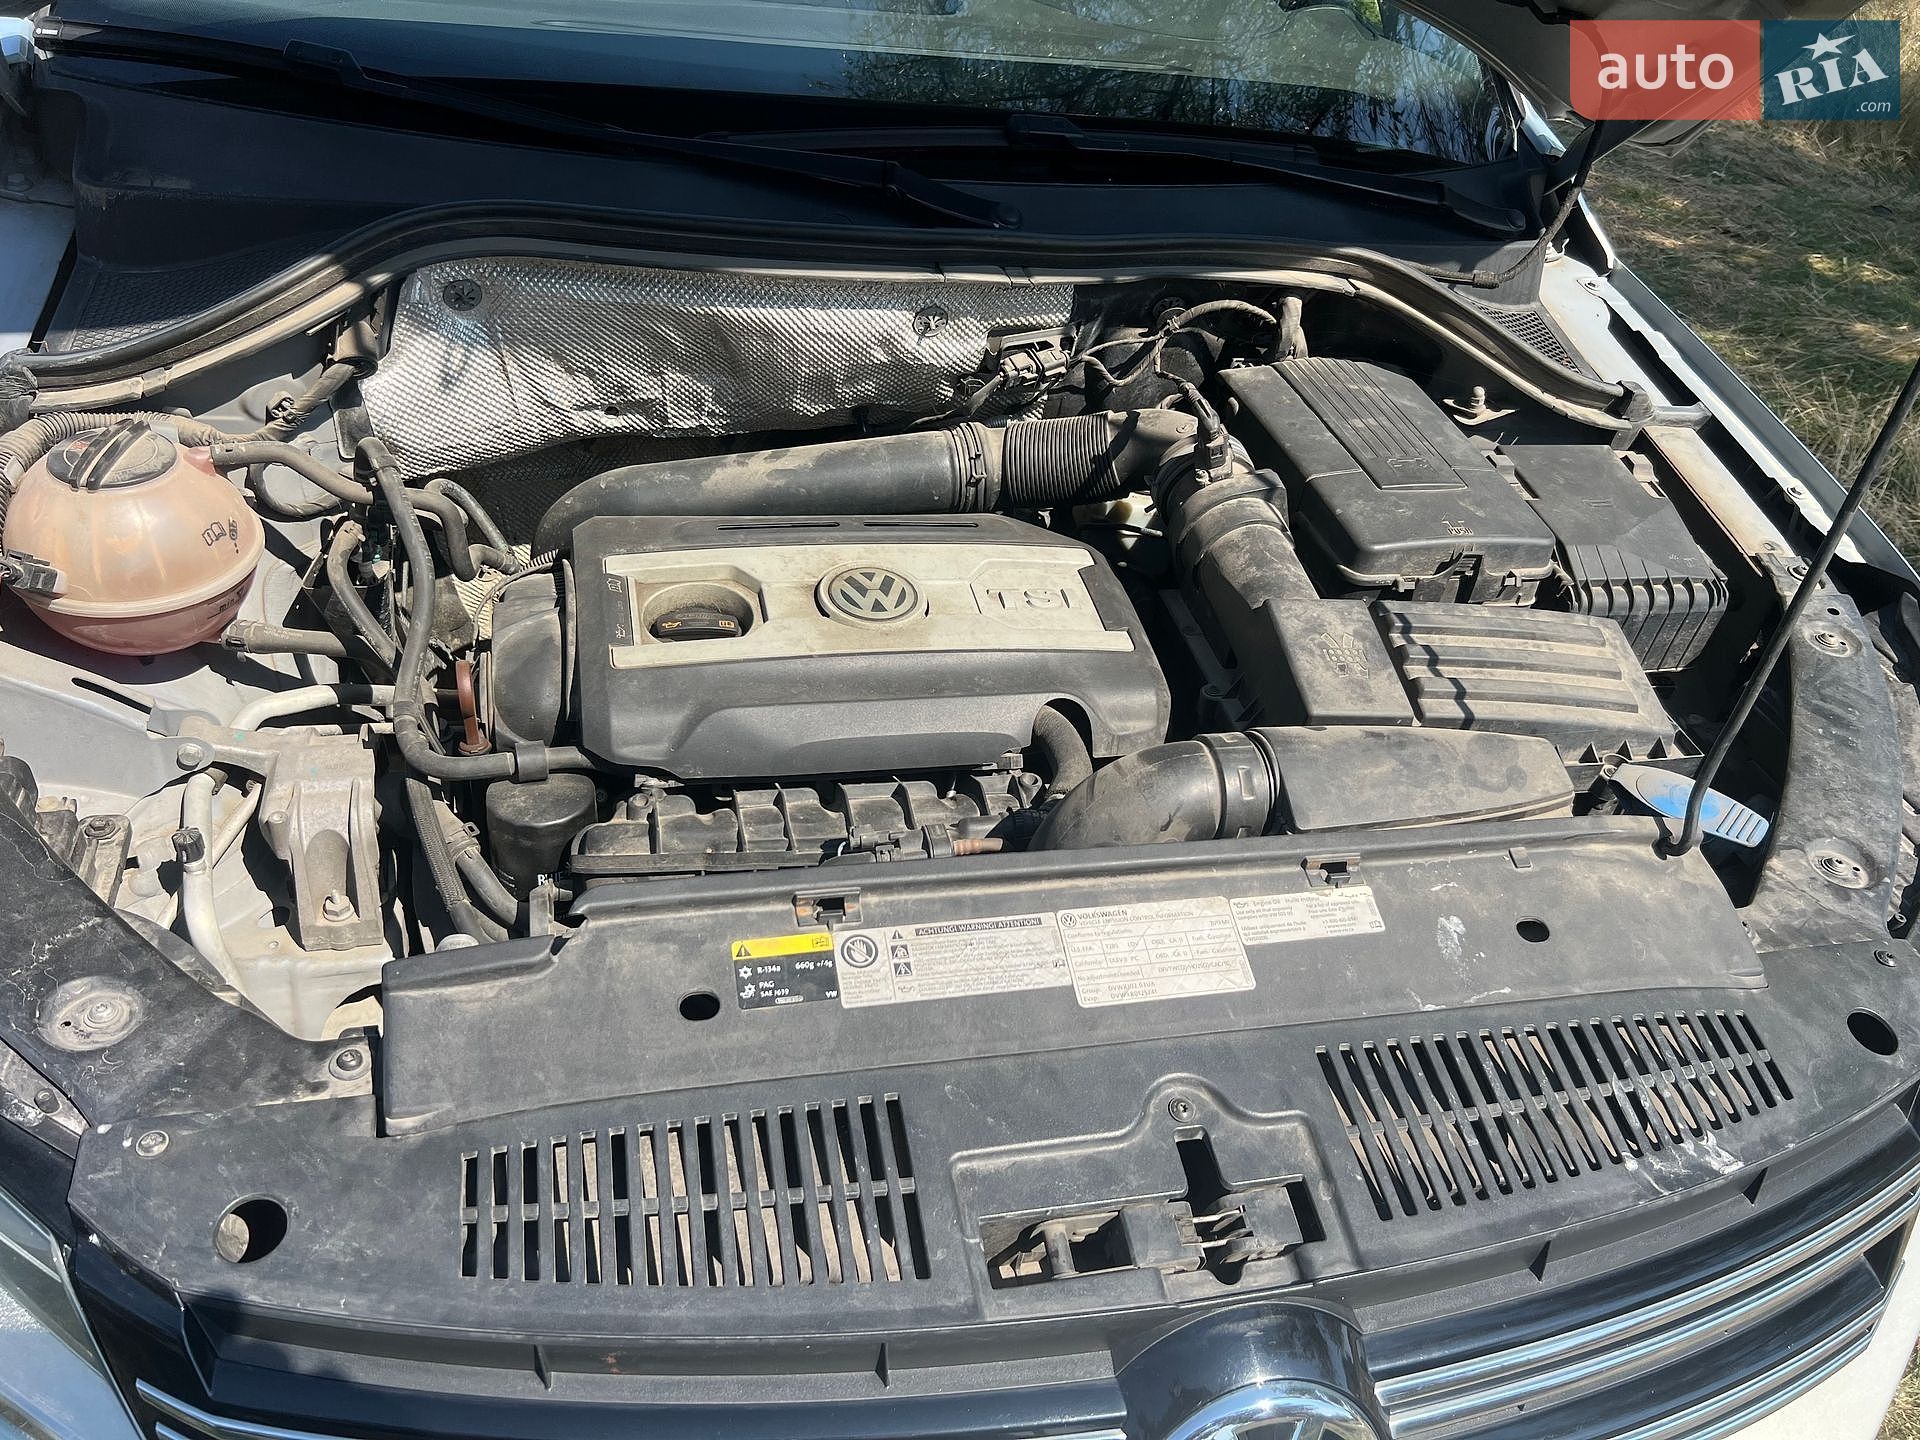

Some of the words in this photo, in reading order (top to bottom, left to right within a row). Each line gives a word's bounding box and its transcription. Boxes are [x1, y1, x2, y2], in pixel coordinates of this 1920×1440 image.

[1447, 527, 1474, 535] PUSH
[985, 586, 1082, 610] TSI
[1077, 909, 1128, 920] VOLKSWAGEN
[919, 925, 957, 936] ACHTUNG!
[959, 922, 997, 932] WARNING!
[795, 961, 814, 971] 660g
[759, 980, 775, 989] PAG
[825, 990, 838, 998] VW
